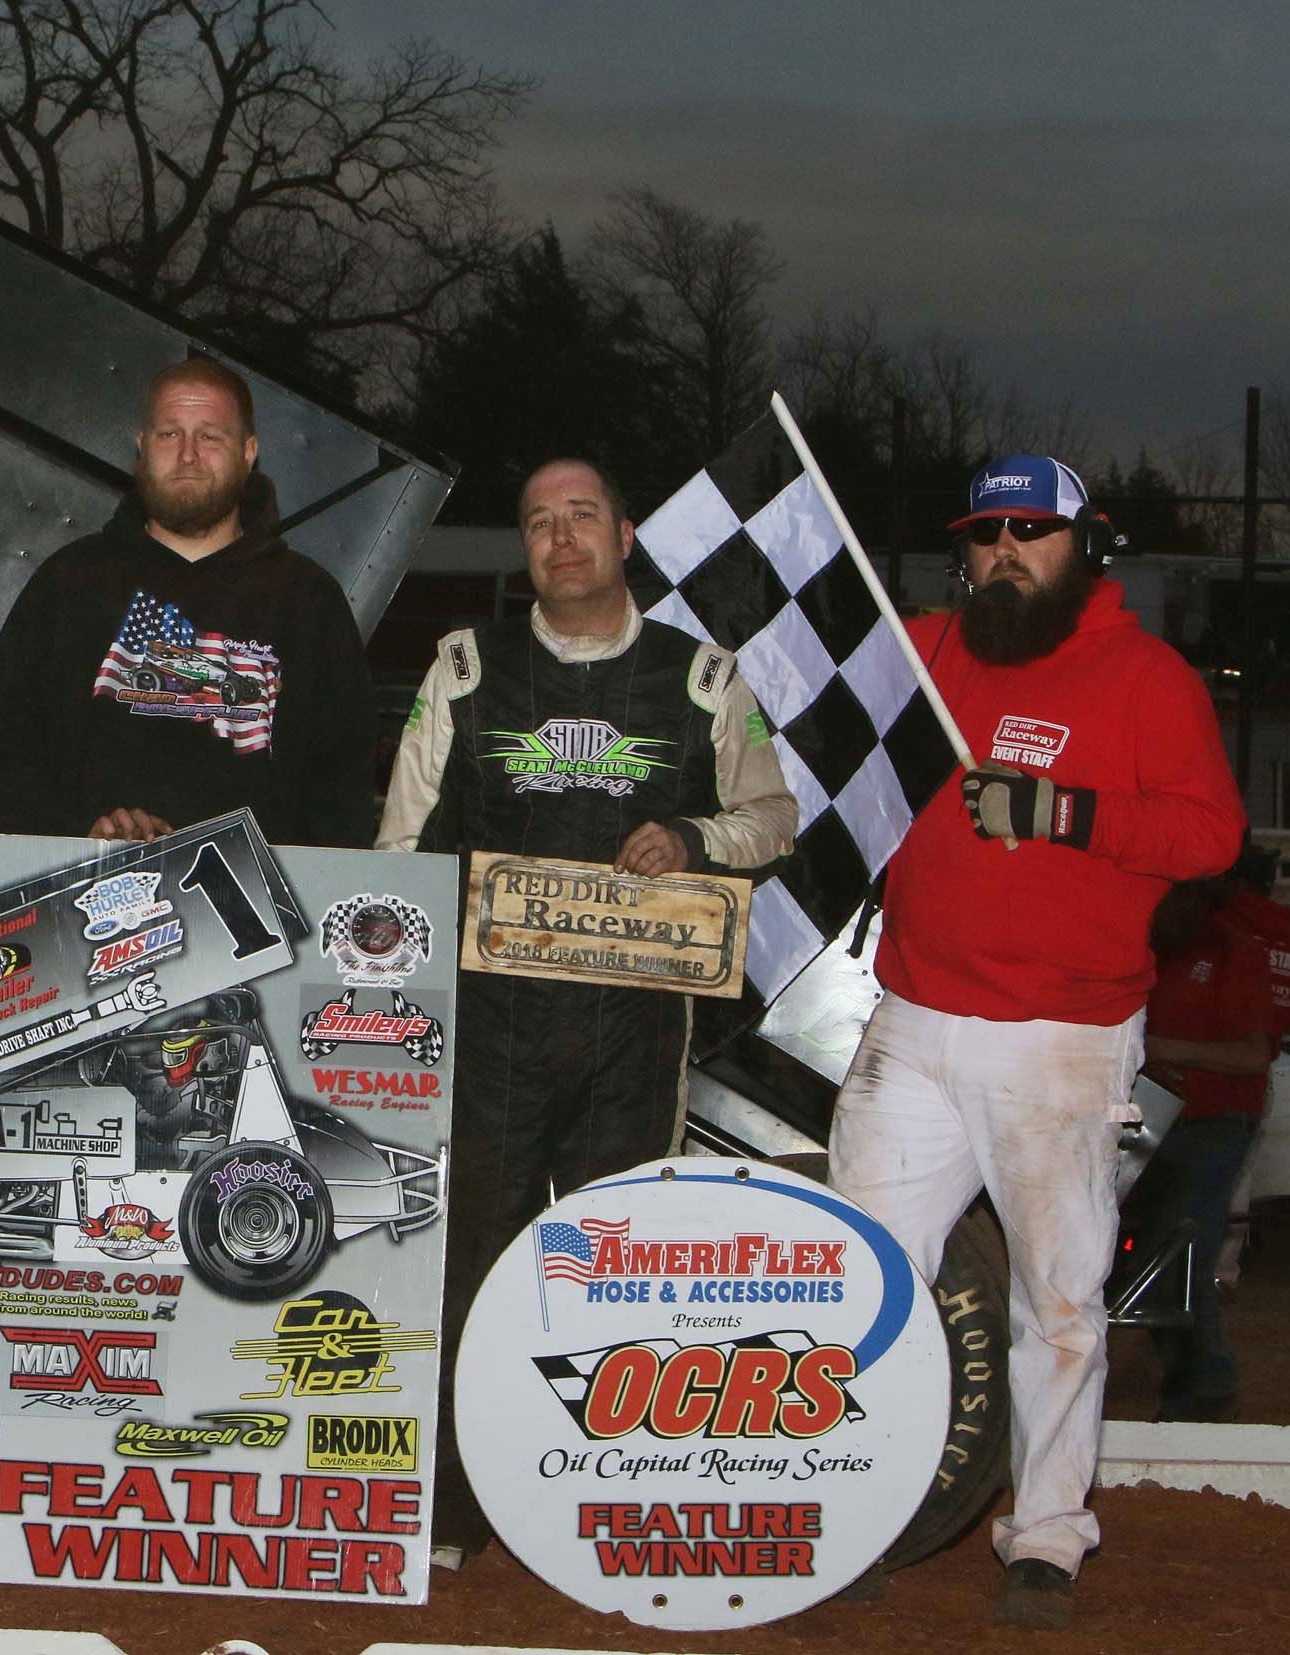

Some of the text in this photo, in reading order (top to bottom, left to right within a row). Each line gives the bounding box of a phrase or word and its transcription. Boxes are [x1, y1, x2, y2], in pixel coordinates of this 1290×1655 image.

[984, 476, 1031, 490] PATRIOT
[1001, 728, 1057, 747] Raceway
[508, 760, 547, 774] SEAN
[991, 746, 1054, 769] EVENT STAFF
[512, 775, 634, 797] Racing
[90, 884, 153, 915] HURLEY
[98, 876, 134, 898] BOB
[504, 872, 646, 907] RED DIRT
[141, 904, 168, 918] GMC
[179, 842, 282, 961] 1
[93, 910, 116, 921] AUTO
[521, 898, 698, 950] Raceway
[93, 921, 182, 973] AMSOIL
[120, 947, 182, 973] RACING
[340, 961, 359, 972] The
[549, 946, 628, 969] FEATURE
[633, 956, 705, 978] WINNER
[19, 986, 59, 1012] Repair
[26, 1023, 55, 1045] SHAFT
[56, 1015, 75, 1035] INC.
[316, 1005, 430, 1041] Smiley's
[312, 1069, 442, 1098] WESMAR
[329, 1095, 430, 1111] Racing Engines
[36, 1137, 118, 1152] MACHINE SHOP
[210, 1157, 314, 1203] Hoosier
[75, 1236, 180, 1252] Aluminum Products
[0, 1291, 45, 1303] Racing
[48, 1295, 99, 1307] results,
[102, 1298, 137, 1307] news
[587, 1280, 844, 1303] HOSE & ACCESSORIES
[30, 1306, 77, 1316] around
[80, 1308, 103, 1318] the
[106, 1310, 148, 1320] world!
[273, 1300, 400, 1333] Car
[672, 1312, 742, 1328] Presents
[317, 1332, 355, 1361] &
[11, 1336, 153, 1389] MAXIM
[240, 1352, 402, 1400] Fleet
[584, 1344, 857, 1439] OCRS
[21, 1393, 142, 1417] Racing
[117, 1422, 285, 1447] Maxwell Oil
[312, 1418, 413, 1457] BRODIX
[320, 1457, 403, 1467] CYLINDER HEADS
[539, 1448, 873, 1485] Oil Capital Racing Series
[578, 1503, 822, 1539] FEATURE
[22, 1523, 408, 1596] WINNER
[595, 1541, 815, 1576] WINNER
